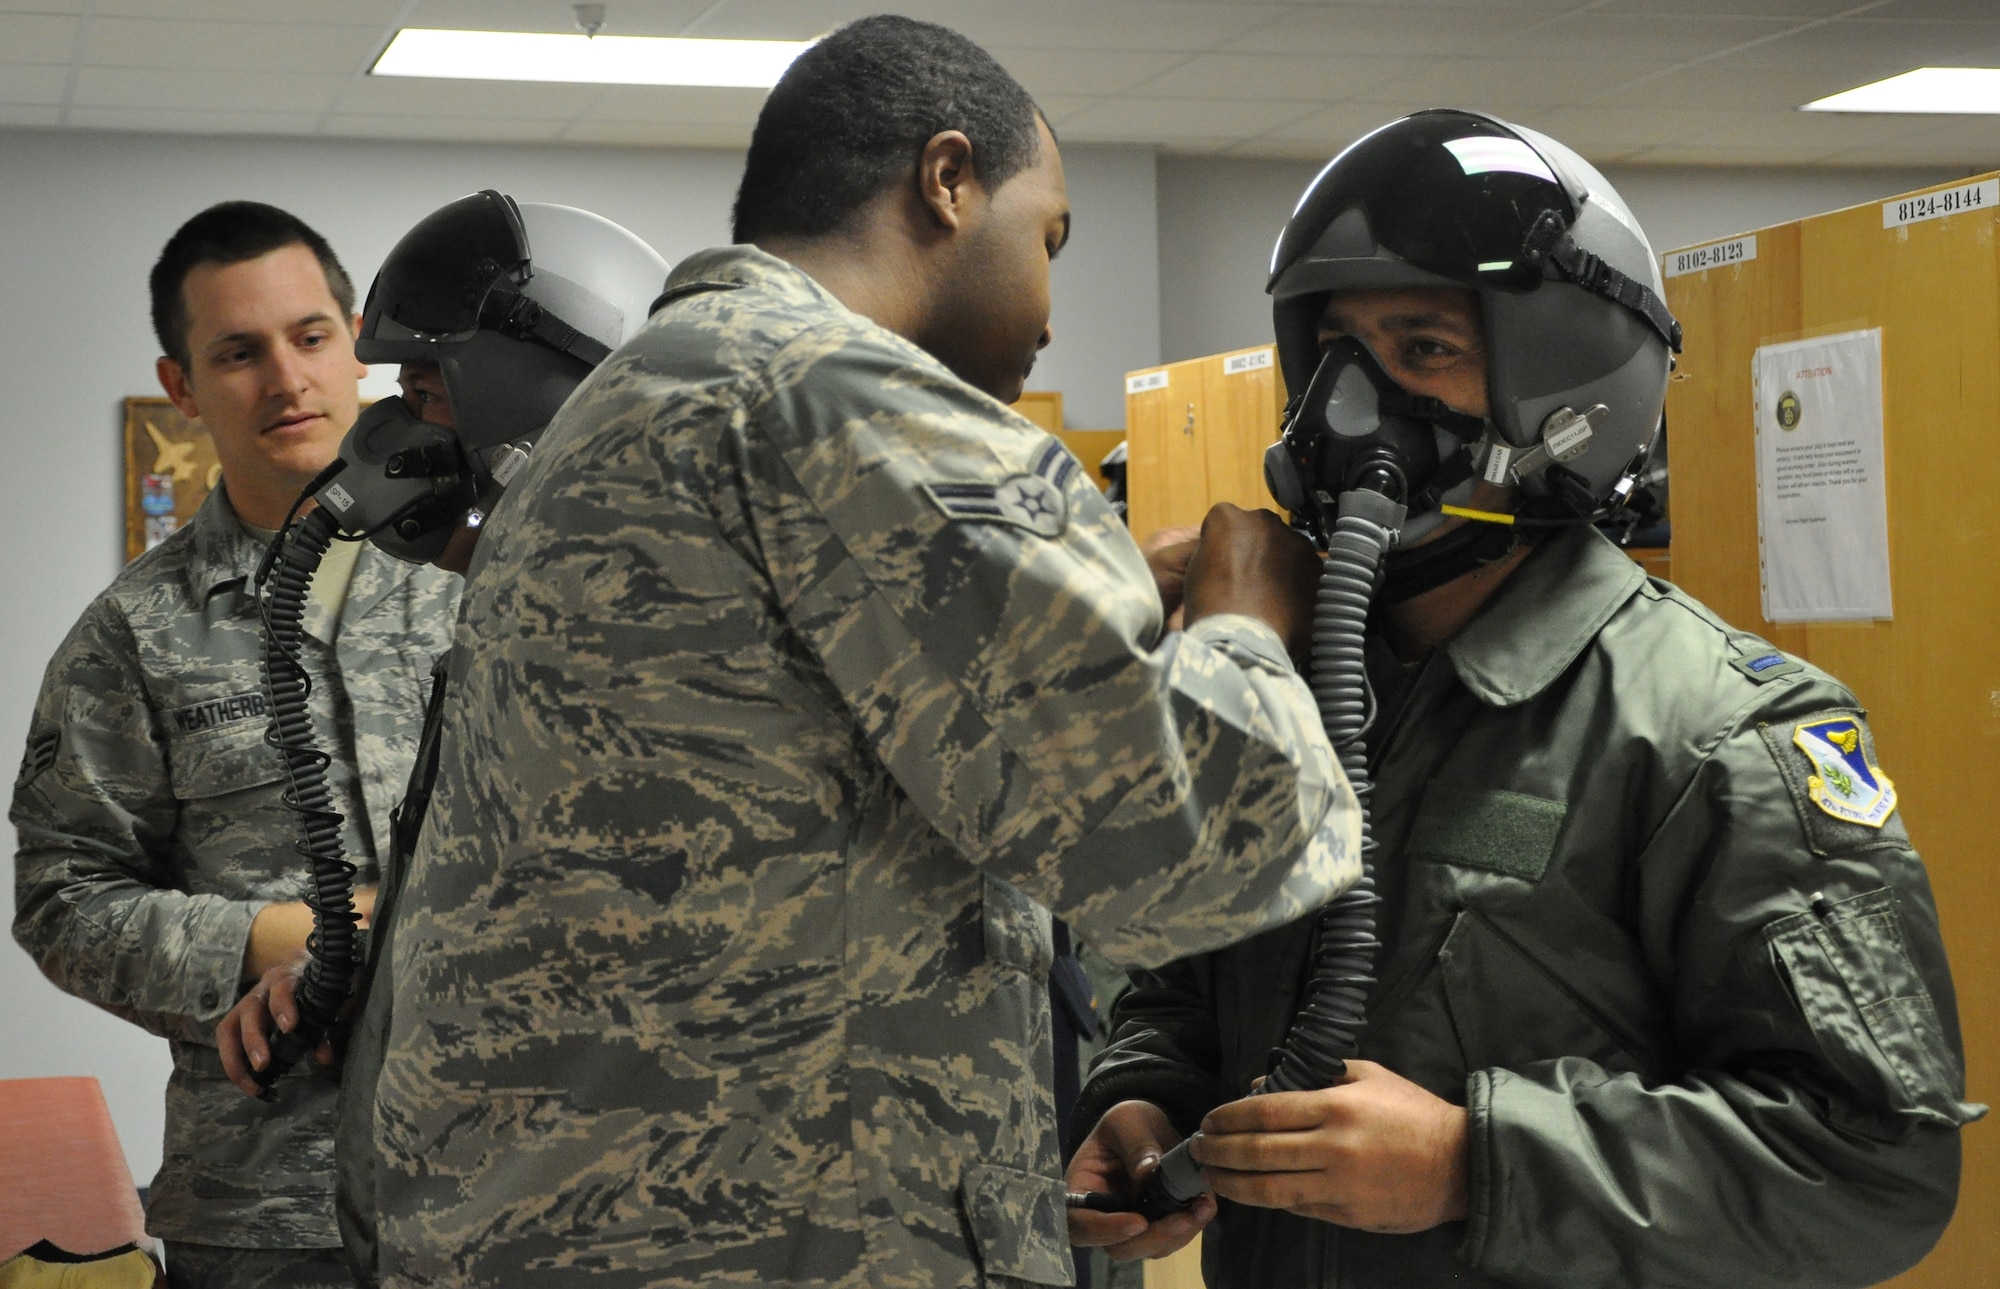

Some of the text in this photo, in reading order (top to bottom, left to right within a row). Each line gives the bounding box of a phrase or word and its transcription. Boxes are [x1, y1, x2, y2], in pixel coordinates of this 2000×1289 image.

[1898, 186, 1982, 222] 8124-8144
[1677, 242, 1743, 272] 8102-8123
[1796, 367, 1833, 380] ATTENTION
[330, 487, 350, 508] SP-15
